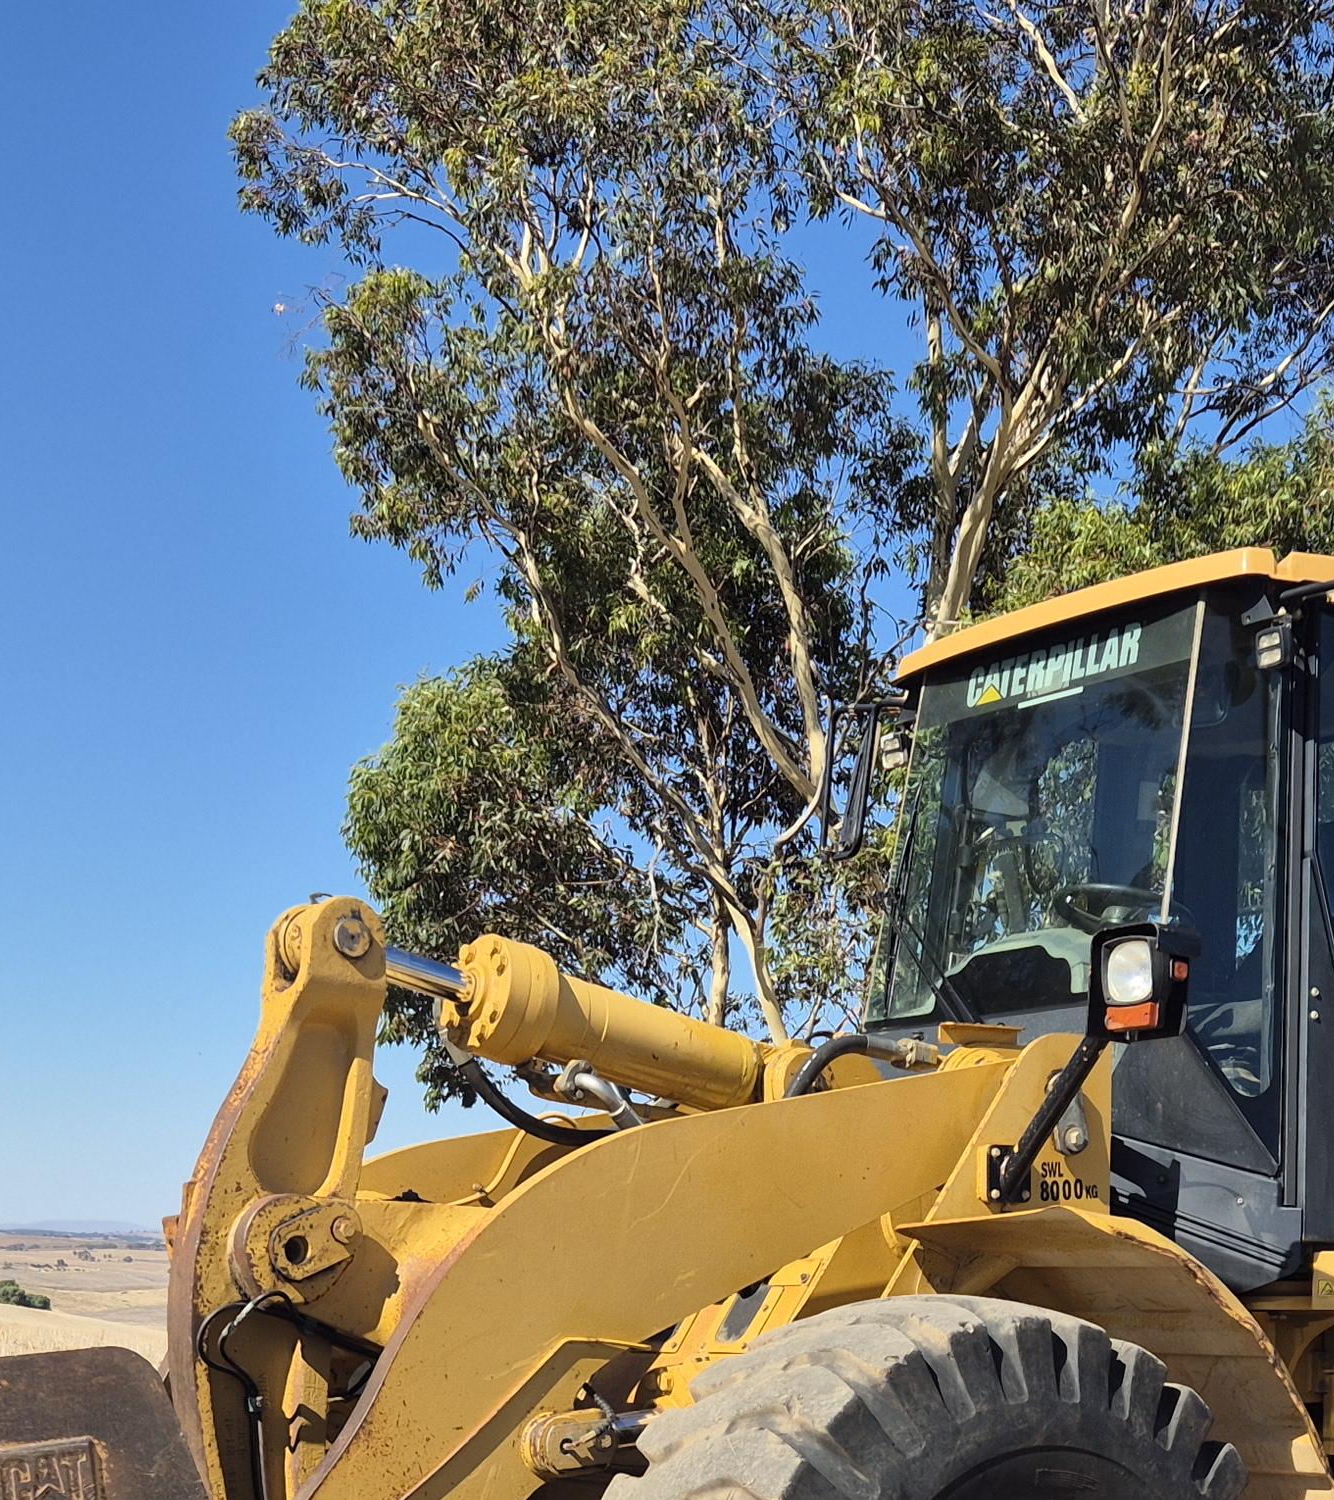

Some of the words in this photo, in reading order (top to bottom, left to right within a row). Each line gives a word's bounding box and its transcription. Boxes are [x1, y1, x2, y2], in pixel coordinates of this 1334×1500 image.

[966, 621, 1143, 708] CATERPILLAR
[1040, 1161, 1064, 1178] SWL
[1040, 1178, 1084, 1202] 8000
[1085, 1184, 1098, 1199] KG
